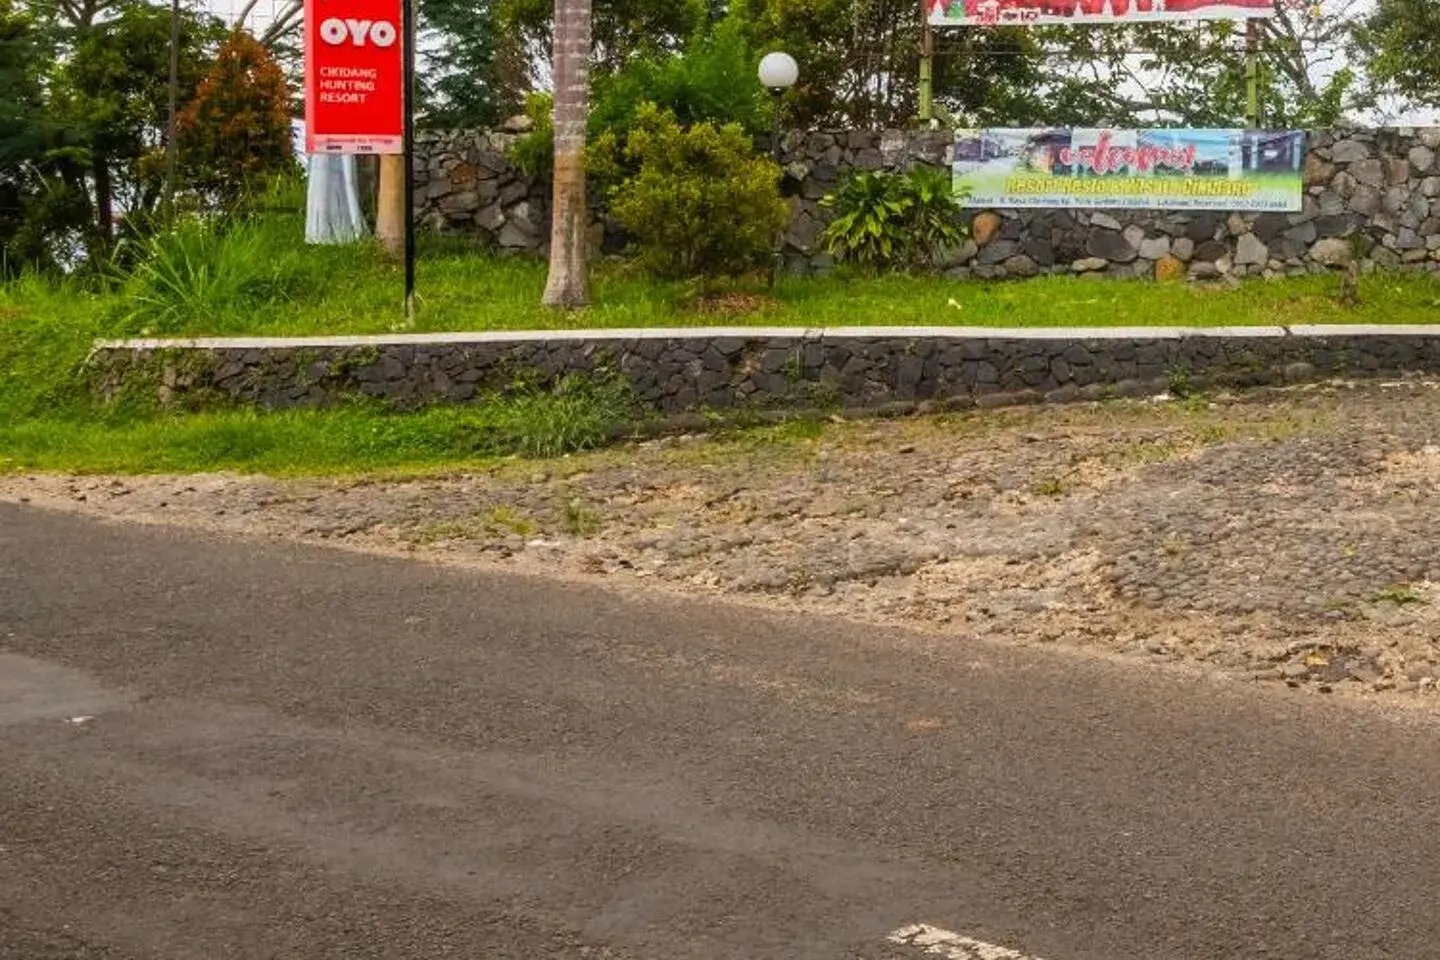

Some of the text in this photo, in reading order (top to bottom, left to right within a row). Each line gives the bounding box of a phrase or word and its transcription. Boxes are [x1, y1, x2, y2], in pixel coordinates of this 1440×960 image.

[320, 18, 397, 47] OYO
[320, 66, 378, 79] CIKIDANG
[320, 80, 376, 92] HUNTING
[320, 92, 367, 104] RESORT
